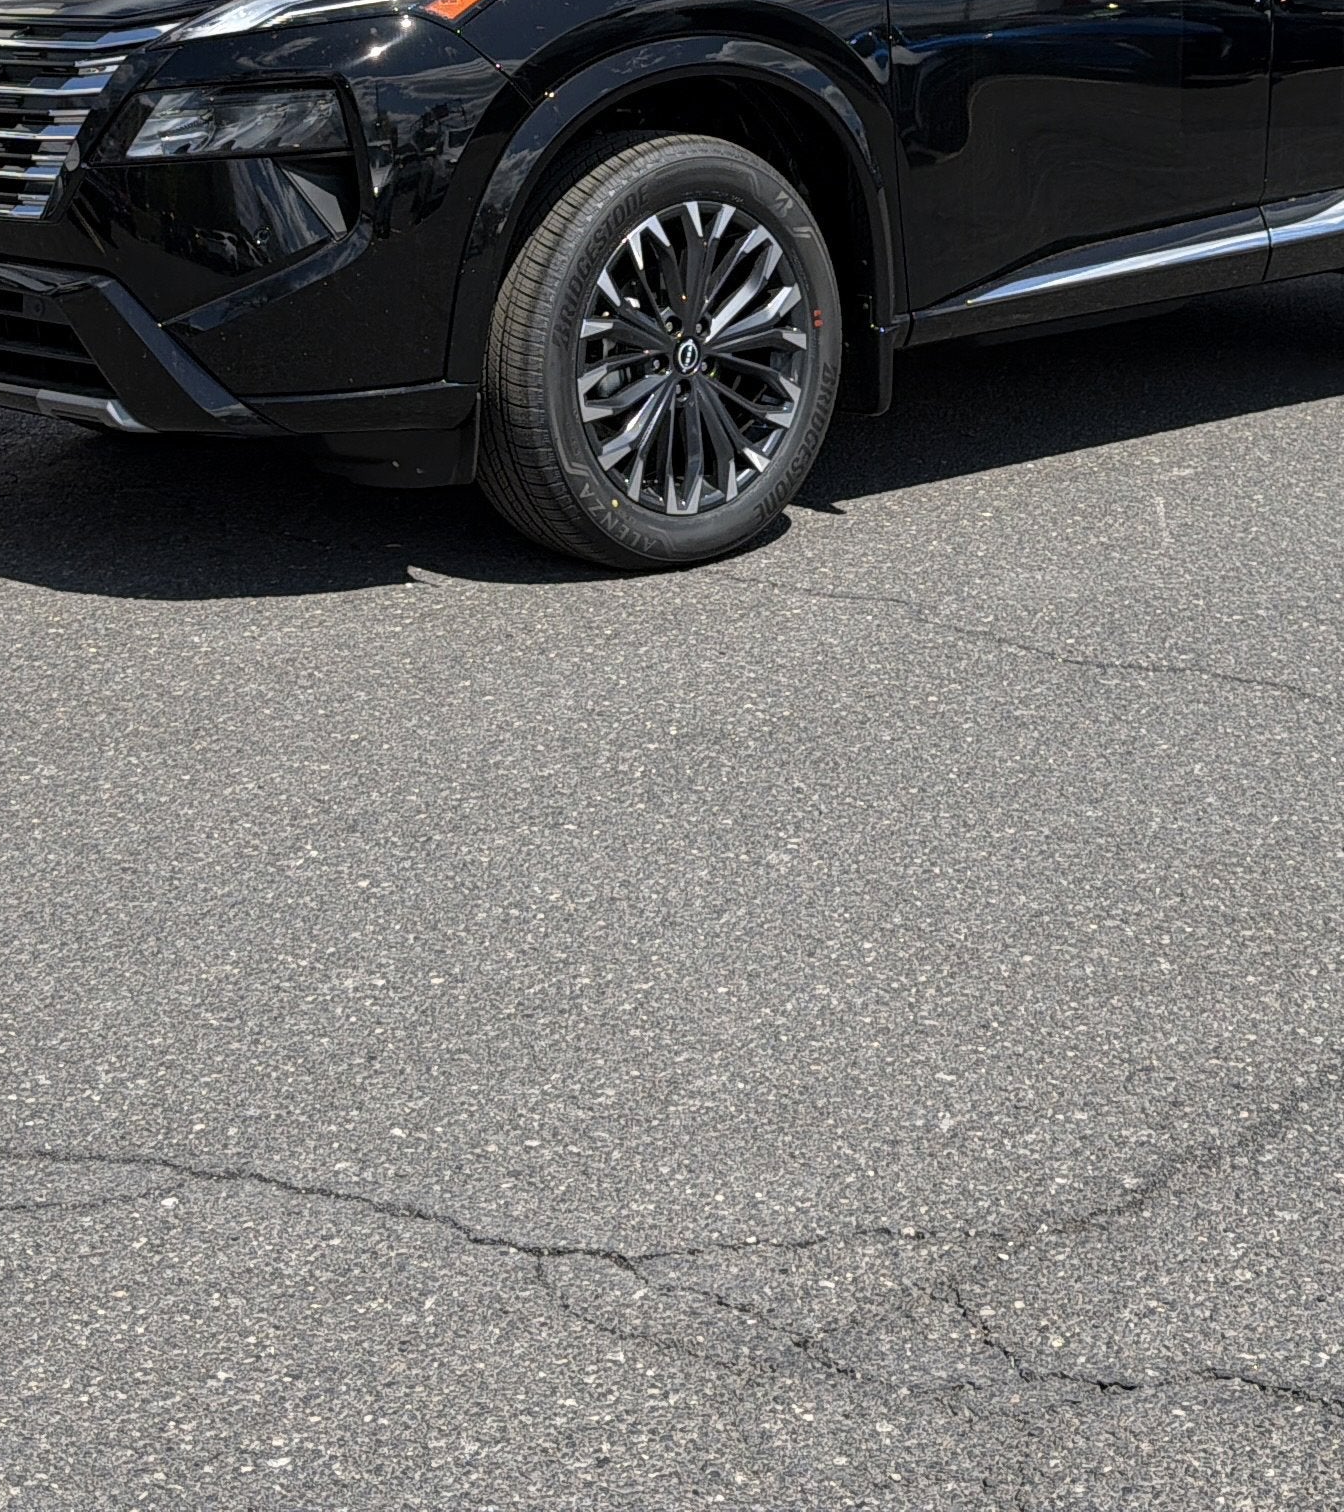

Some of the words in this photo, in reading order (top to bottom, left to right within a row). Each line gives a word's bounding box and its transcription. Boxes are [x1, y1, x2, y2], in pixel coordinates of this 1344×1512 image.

[553, 182, 650, 352] BRIDGESTONE
[579, 482, 657, 552] ALENZA
[752, 361, 839, 524] BRIDGESTONE
